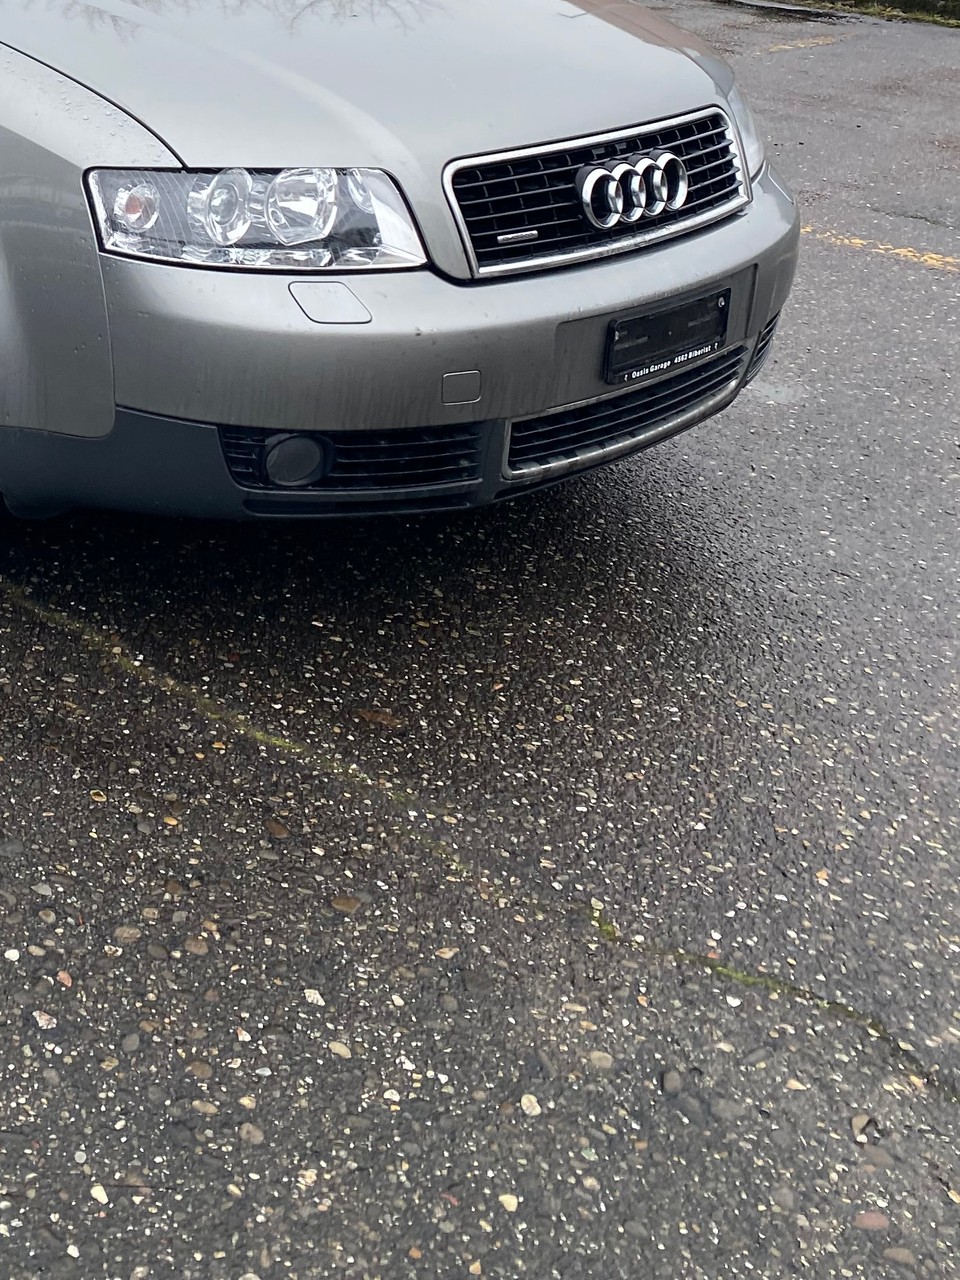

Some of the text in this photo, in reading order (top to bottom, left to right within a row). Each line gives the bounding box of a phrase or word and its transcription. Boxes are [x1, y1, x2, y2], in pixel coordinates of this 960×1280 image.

[631, 367, 649, 379] Oasis
[649, 360, 671, 373] Garage
[688, 345, 712, 359] Biberist
